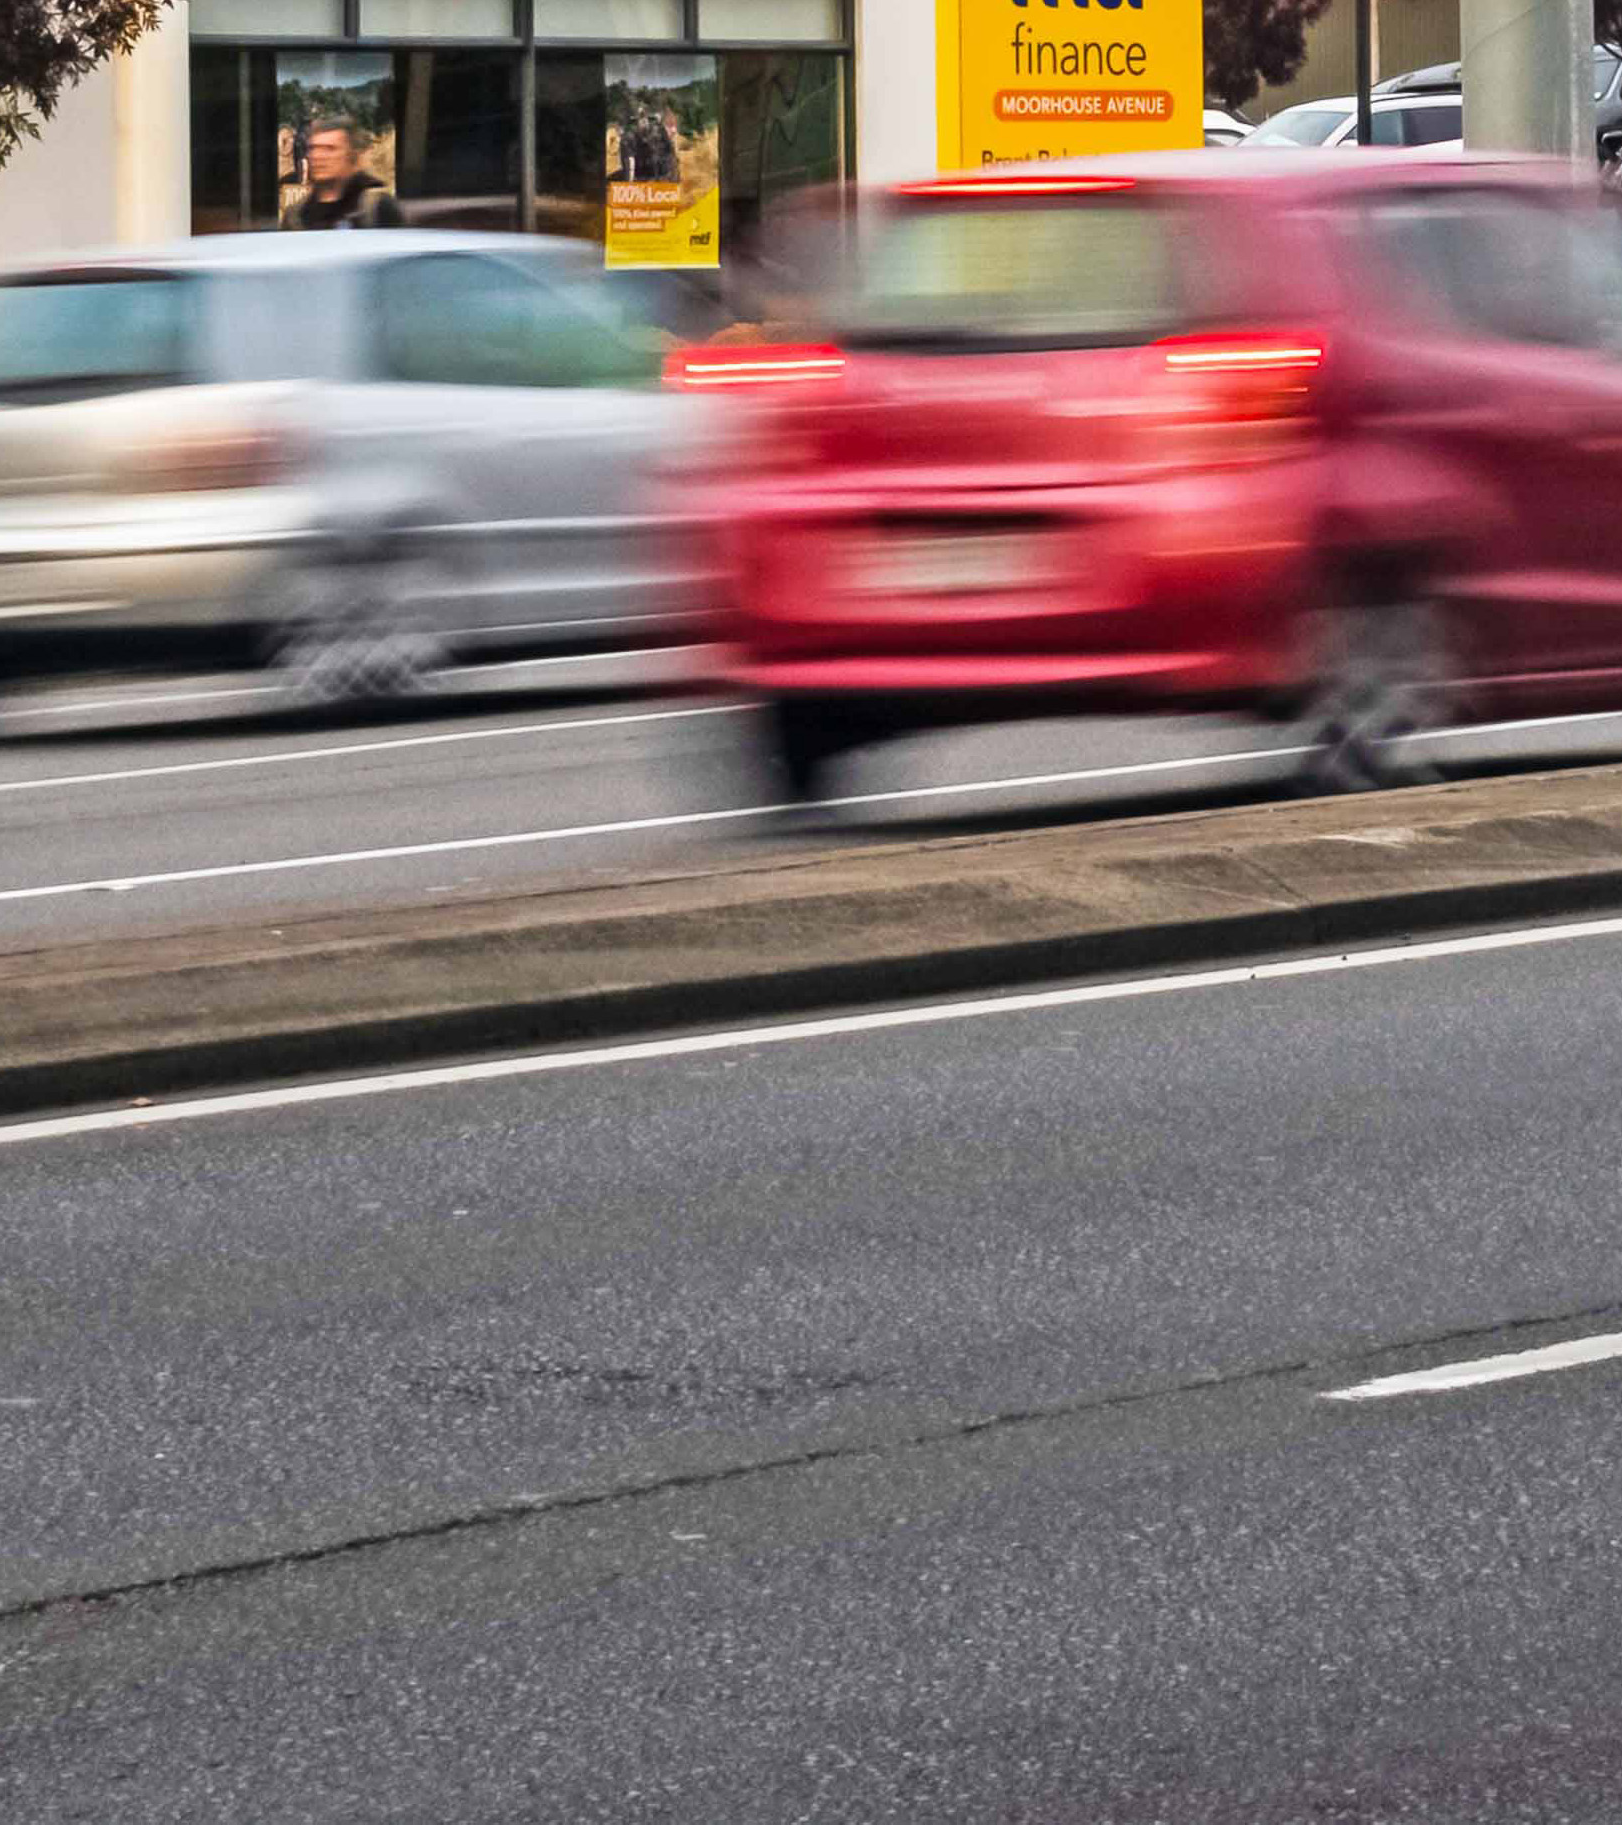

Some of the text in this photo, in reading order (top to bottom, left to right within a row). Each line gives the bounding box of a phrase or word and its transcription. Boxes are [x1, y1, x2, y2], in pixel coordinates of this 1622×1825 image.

[1011, 21, 1147, 76] finance
[1002, 96, 1166, 114] MOORHOUSE AVENUE
